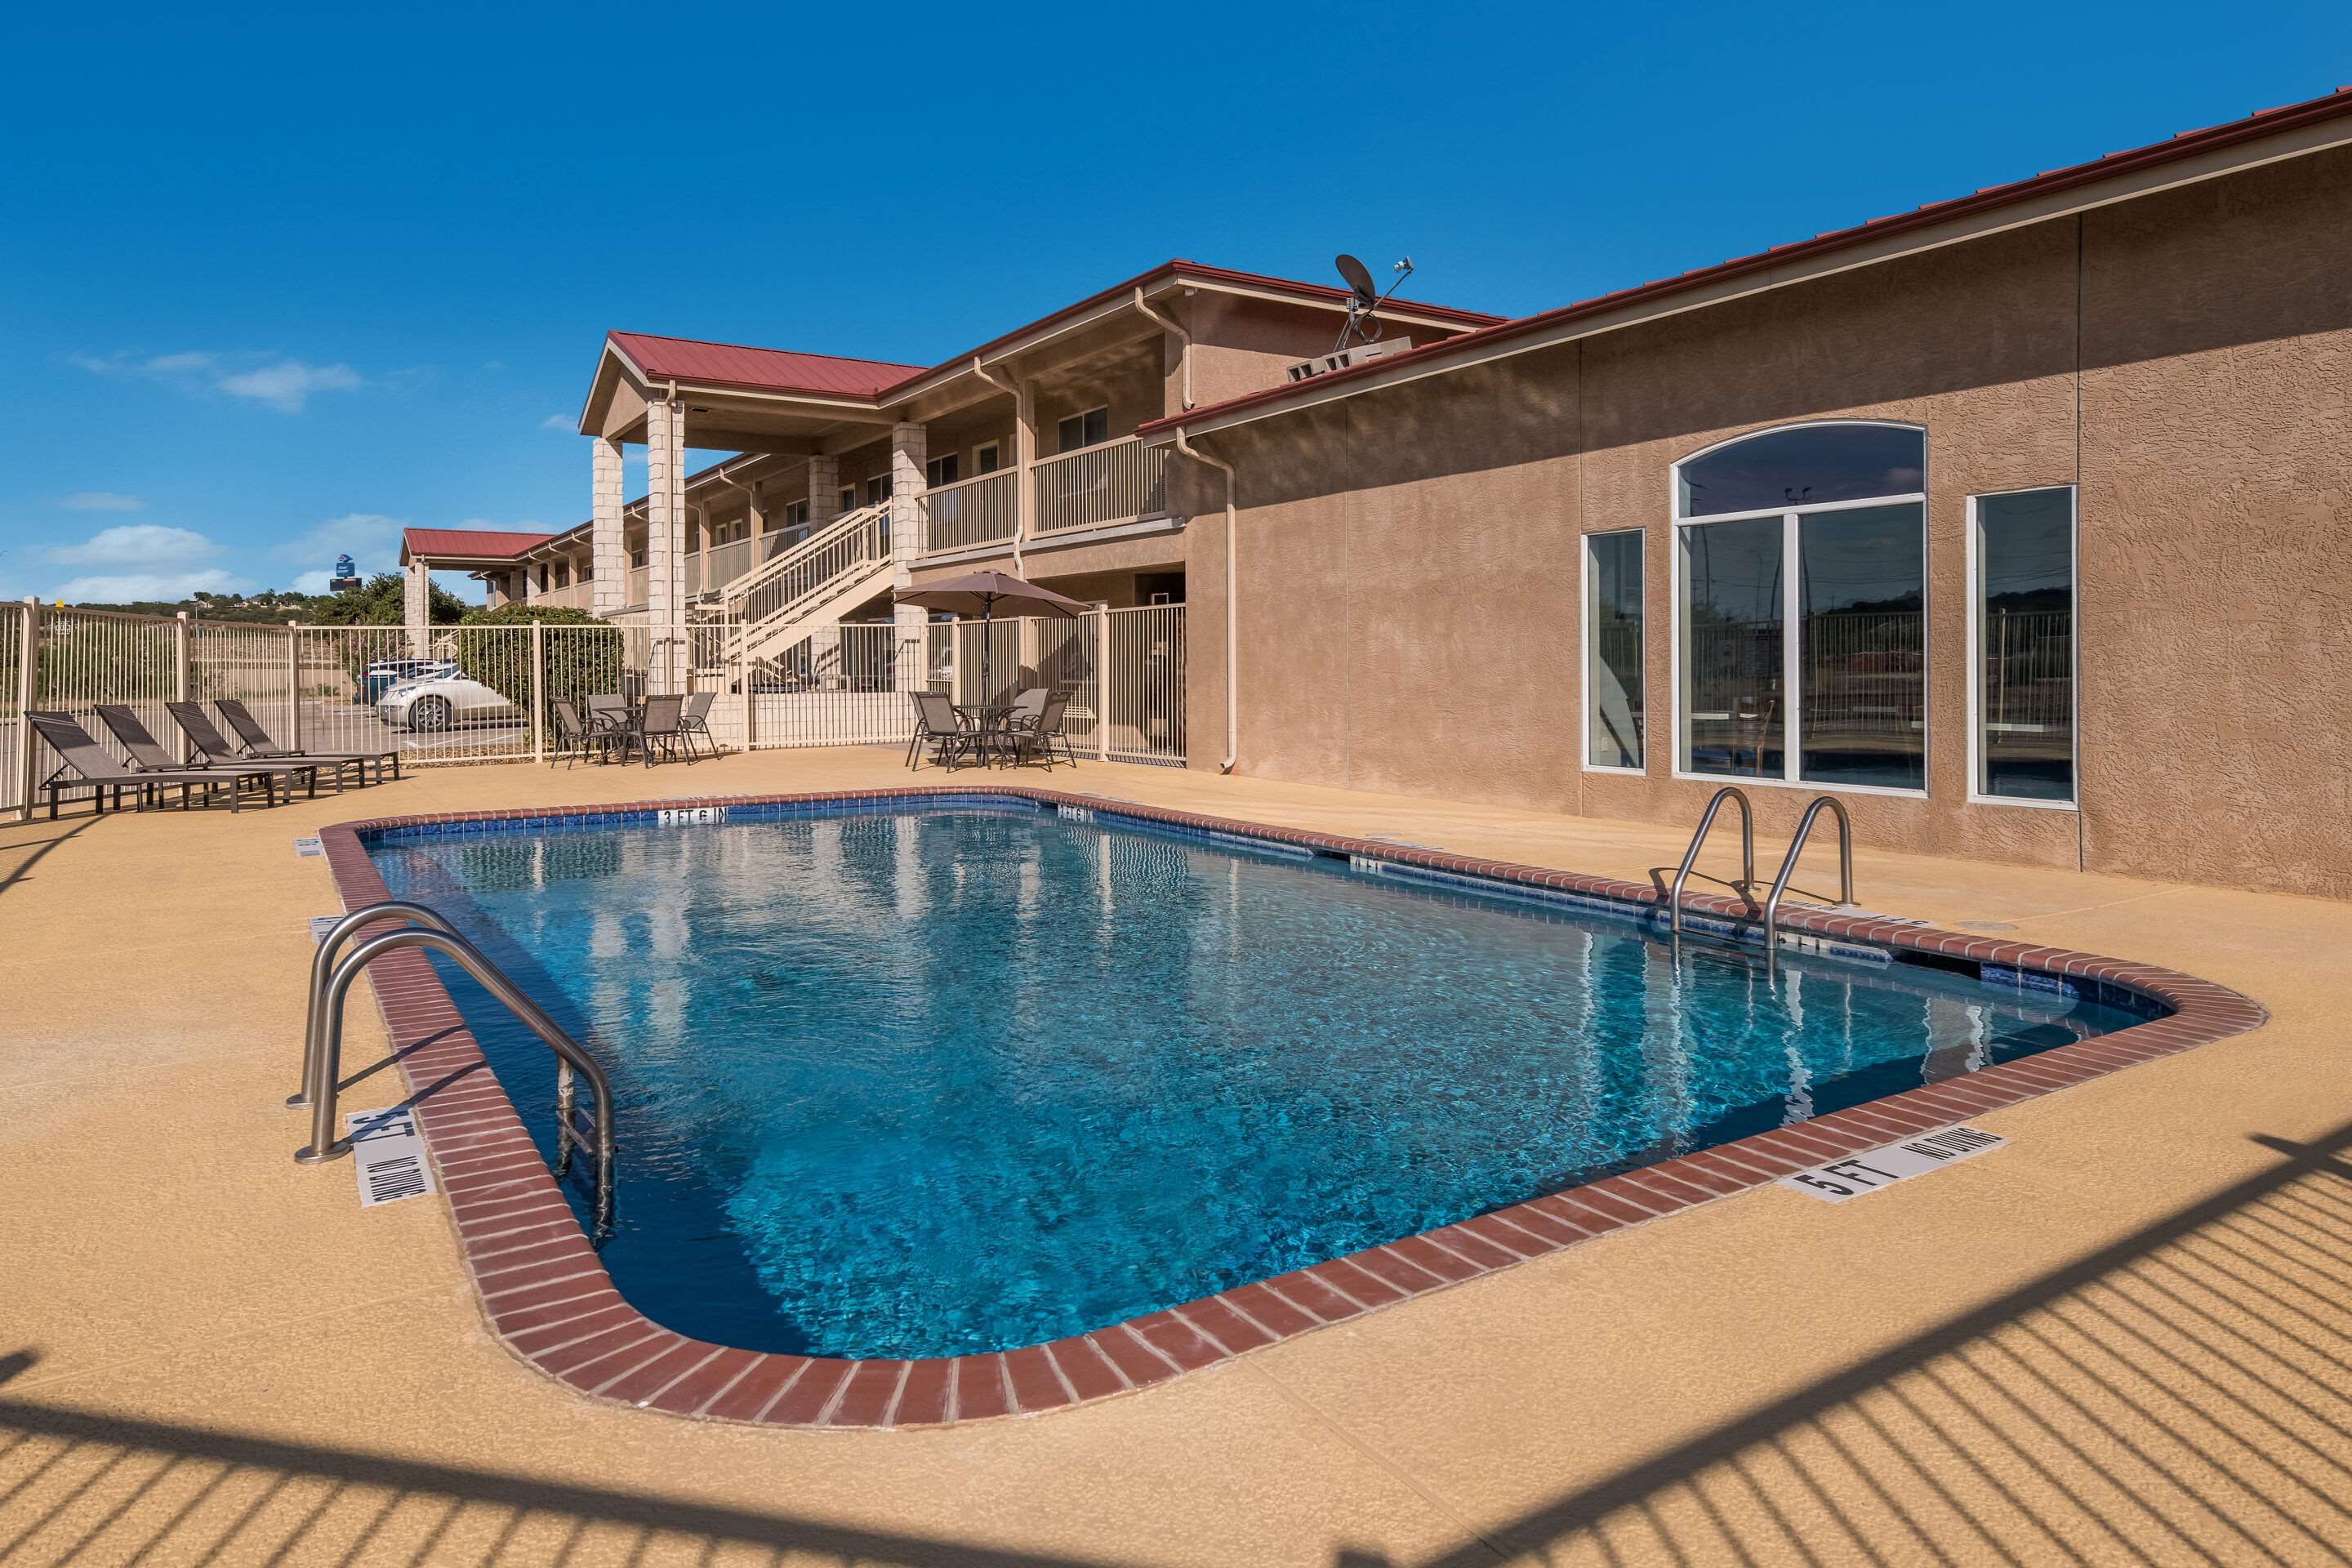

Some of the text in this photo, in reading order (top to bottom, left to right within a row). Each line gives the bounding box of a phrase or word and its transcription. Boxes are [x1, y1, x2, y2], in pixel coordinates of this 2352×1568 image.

[677, 809, 693, 823] FT
[714, 807, 727, 823] IN
[354, 1122, 415, 1142] FT
[367, 1156, 419, 1173] NO
[1793, 1128, 2005, 1195] 5 FT NO DIVING
[369, 1168, 426, 1201] DIVING
